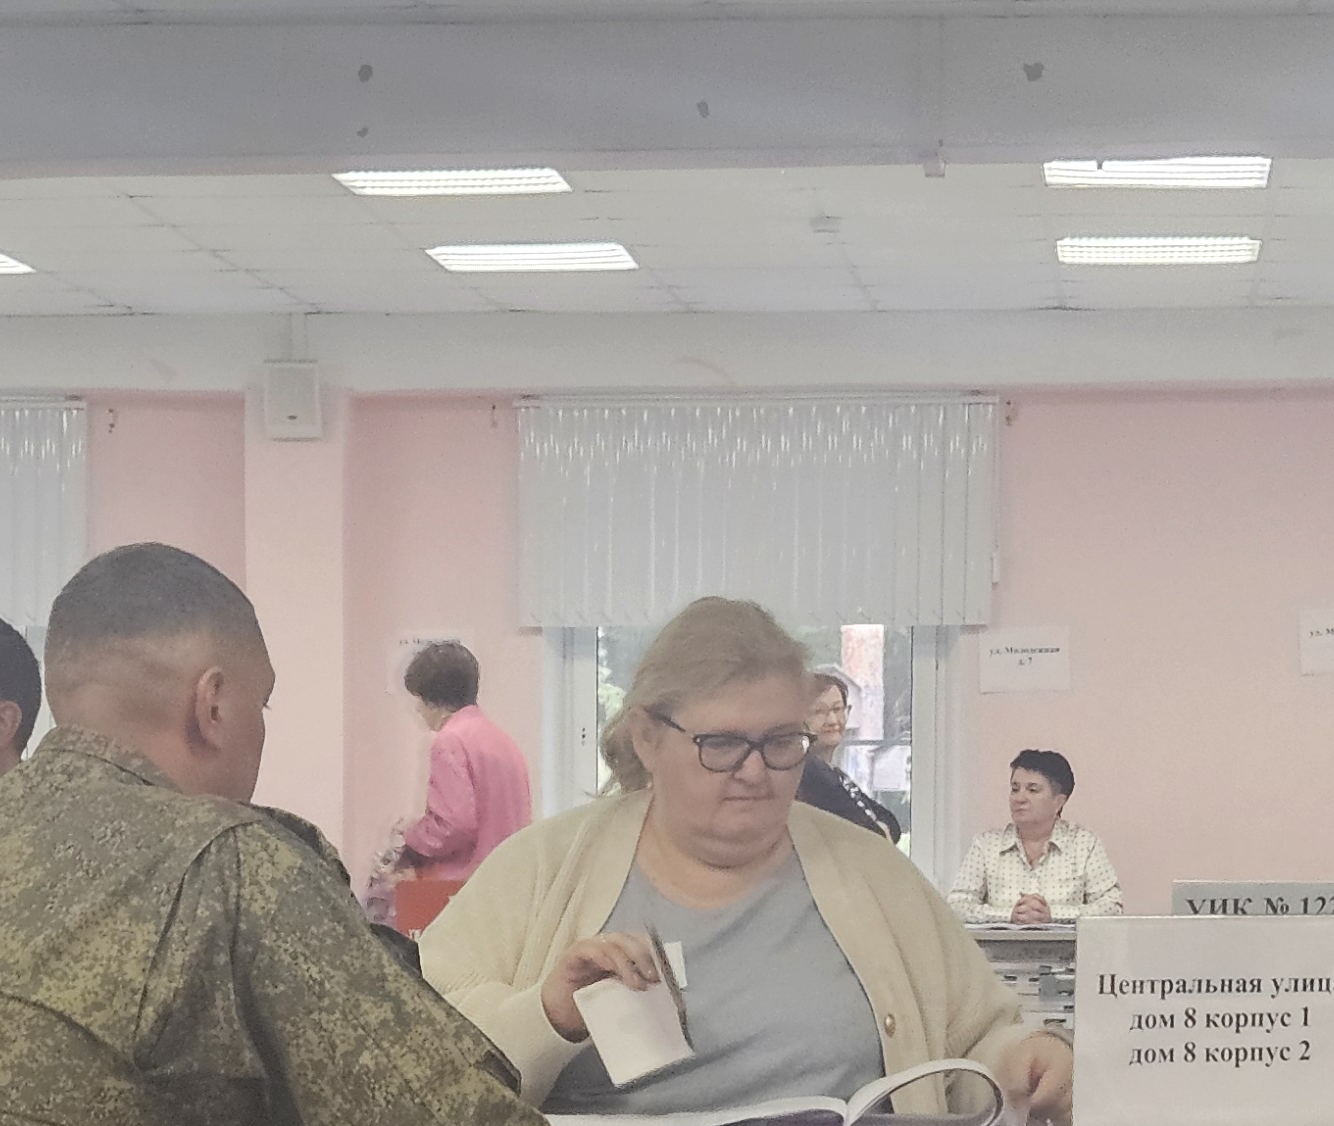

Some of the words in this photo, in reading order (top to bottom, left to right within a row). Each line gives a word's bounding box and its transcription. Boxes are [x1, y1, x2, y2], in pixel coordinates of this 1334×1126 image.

[1097, 972, 1262, 1001] Центральная
[1128, 1012, 1175, 1032] дом
[1183, 1006, 1197, 1029] 8
[1204, 1011, 1292, 1034] корпус
[1301, 1006, 1310, 1027] 1
[1128, 1047, 1175, 1067] дом
[1183, 1041, 1197, 1063] 8
[1204, 1046, 1292, 1069] корпус
[1299, 1039, 1312, 1062] 2
